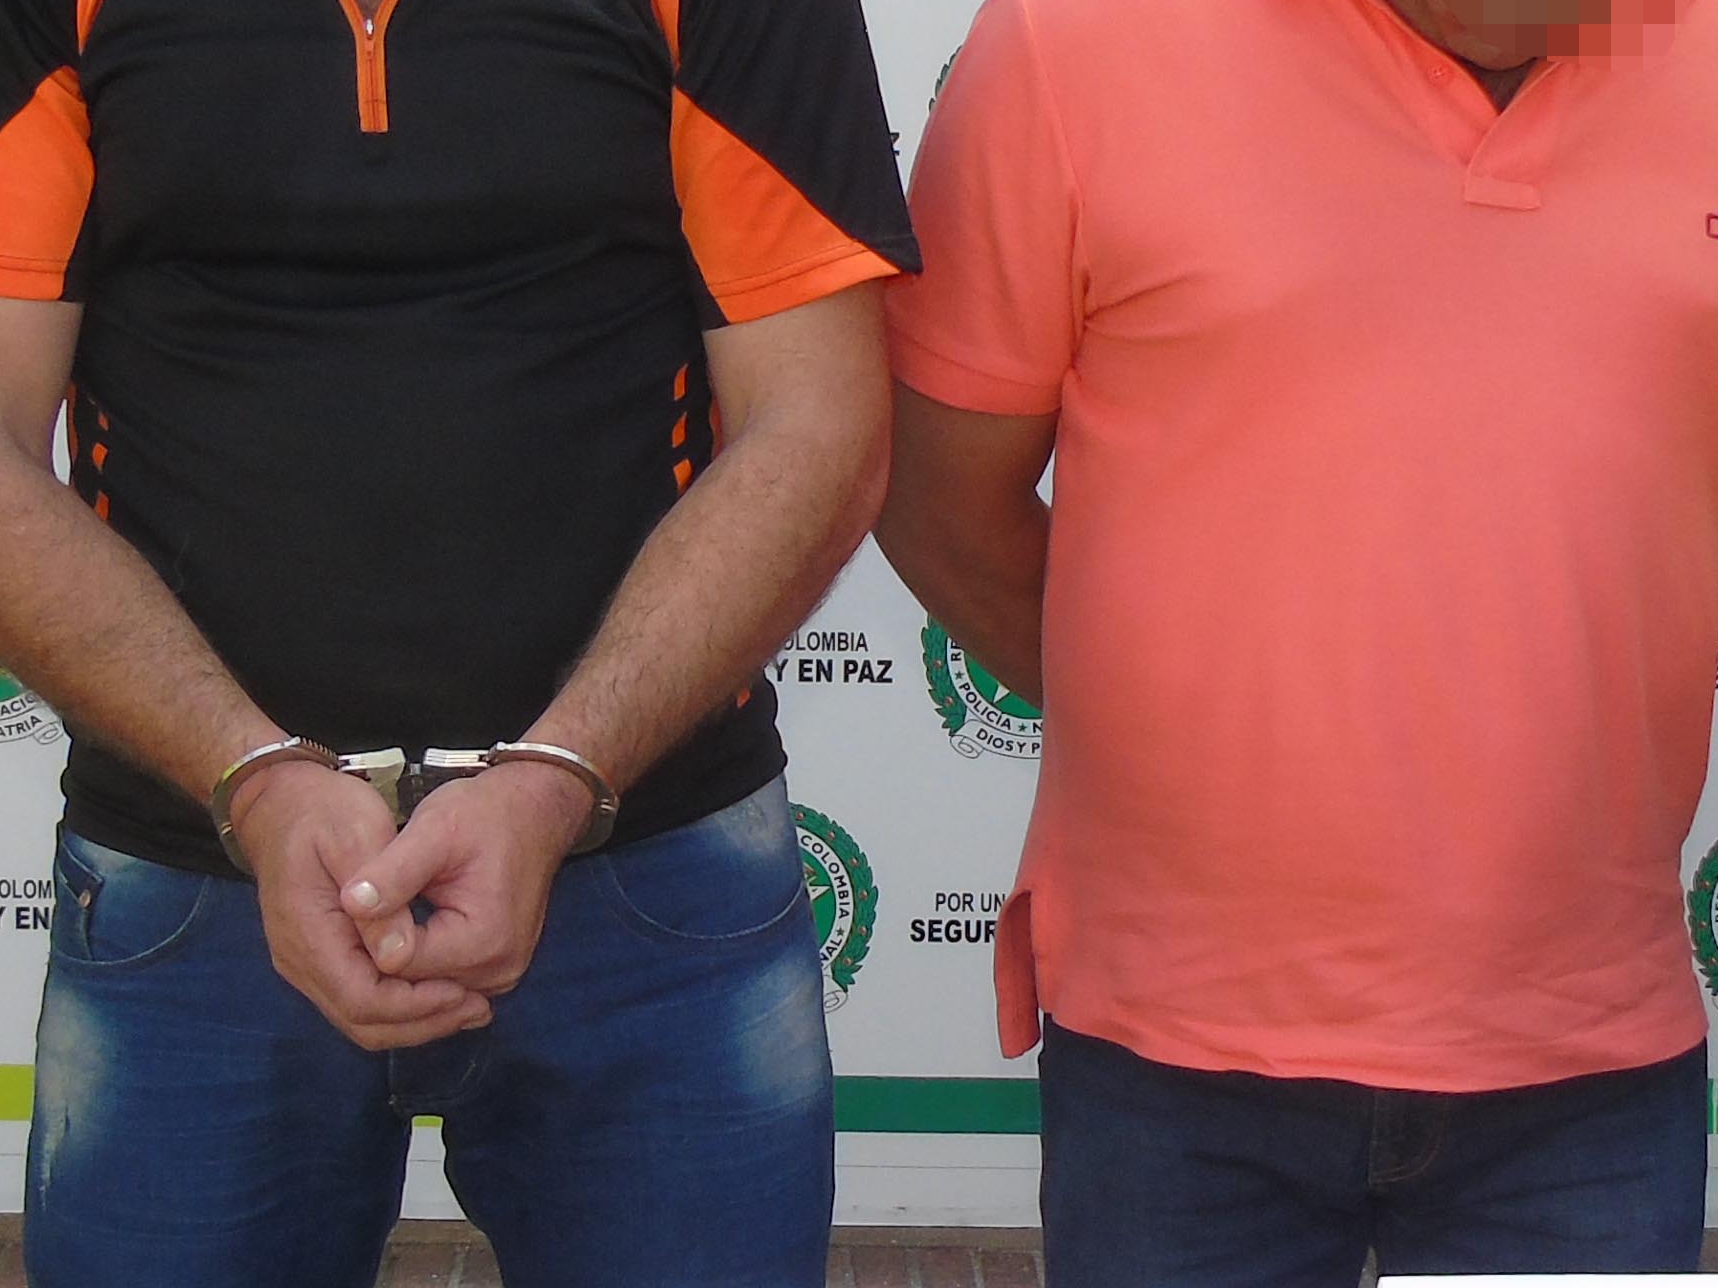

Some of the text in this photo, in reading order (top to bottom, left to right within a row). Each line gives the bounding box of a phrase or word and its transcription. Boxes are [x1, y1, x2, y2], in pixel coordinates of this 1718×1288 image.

[784, 631, 868, 652] OLOMBIA
[775, 659, 893, 683] Y EN PAZ
[976, 728, 1015, 752] DIOS
[1016, 741, 1028, 754] Y
[800, 834, 851, 920] COLOMBIA
[935, 892, 1006, 912] POR UN
[15, 906, 51, 930] EN
[910, 919, 998, 943] SEGUR
